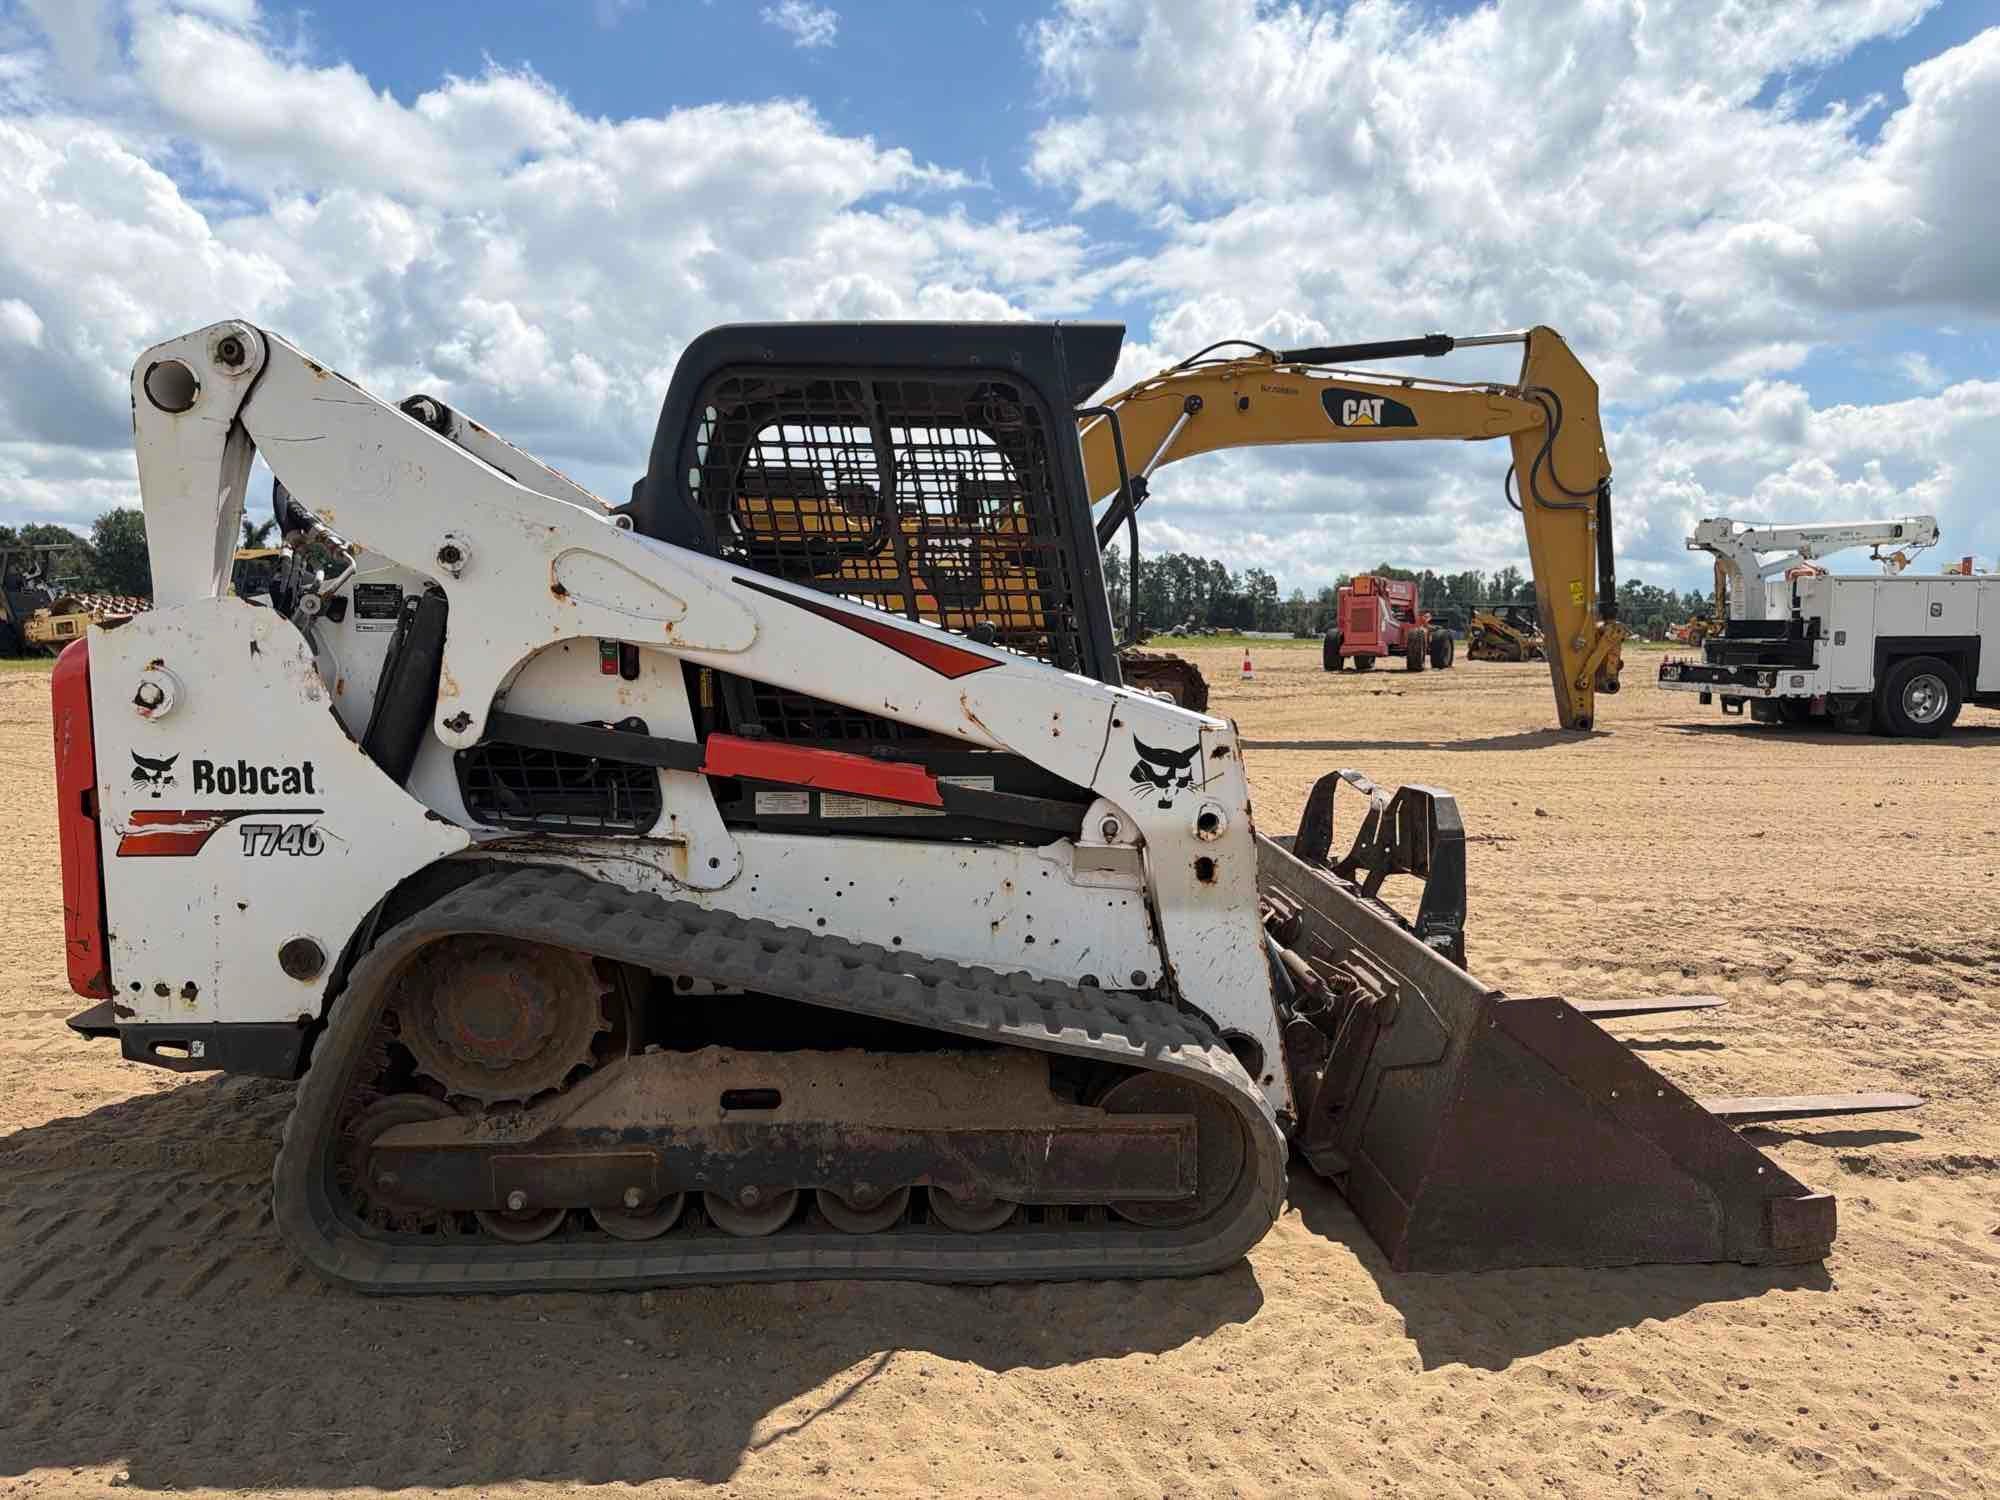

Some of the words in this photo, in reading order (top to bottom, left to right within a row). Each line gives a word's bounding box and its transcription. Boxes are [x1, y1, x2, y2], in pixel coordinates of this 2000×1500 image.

[1342, 399, 1385, 425] CAT
[192, 759, 315, 795] Bobcat
[240, 824, 325, 857] T740
